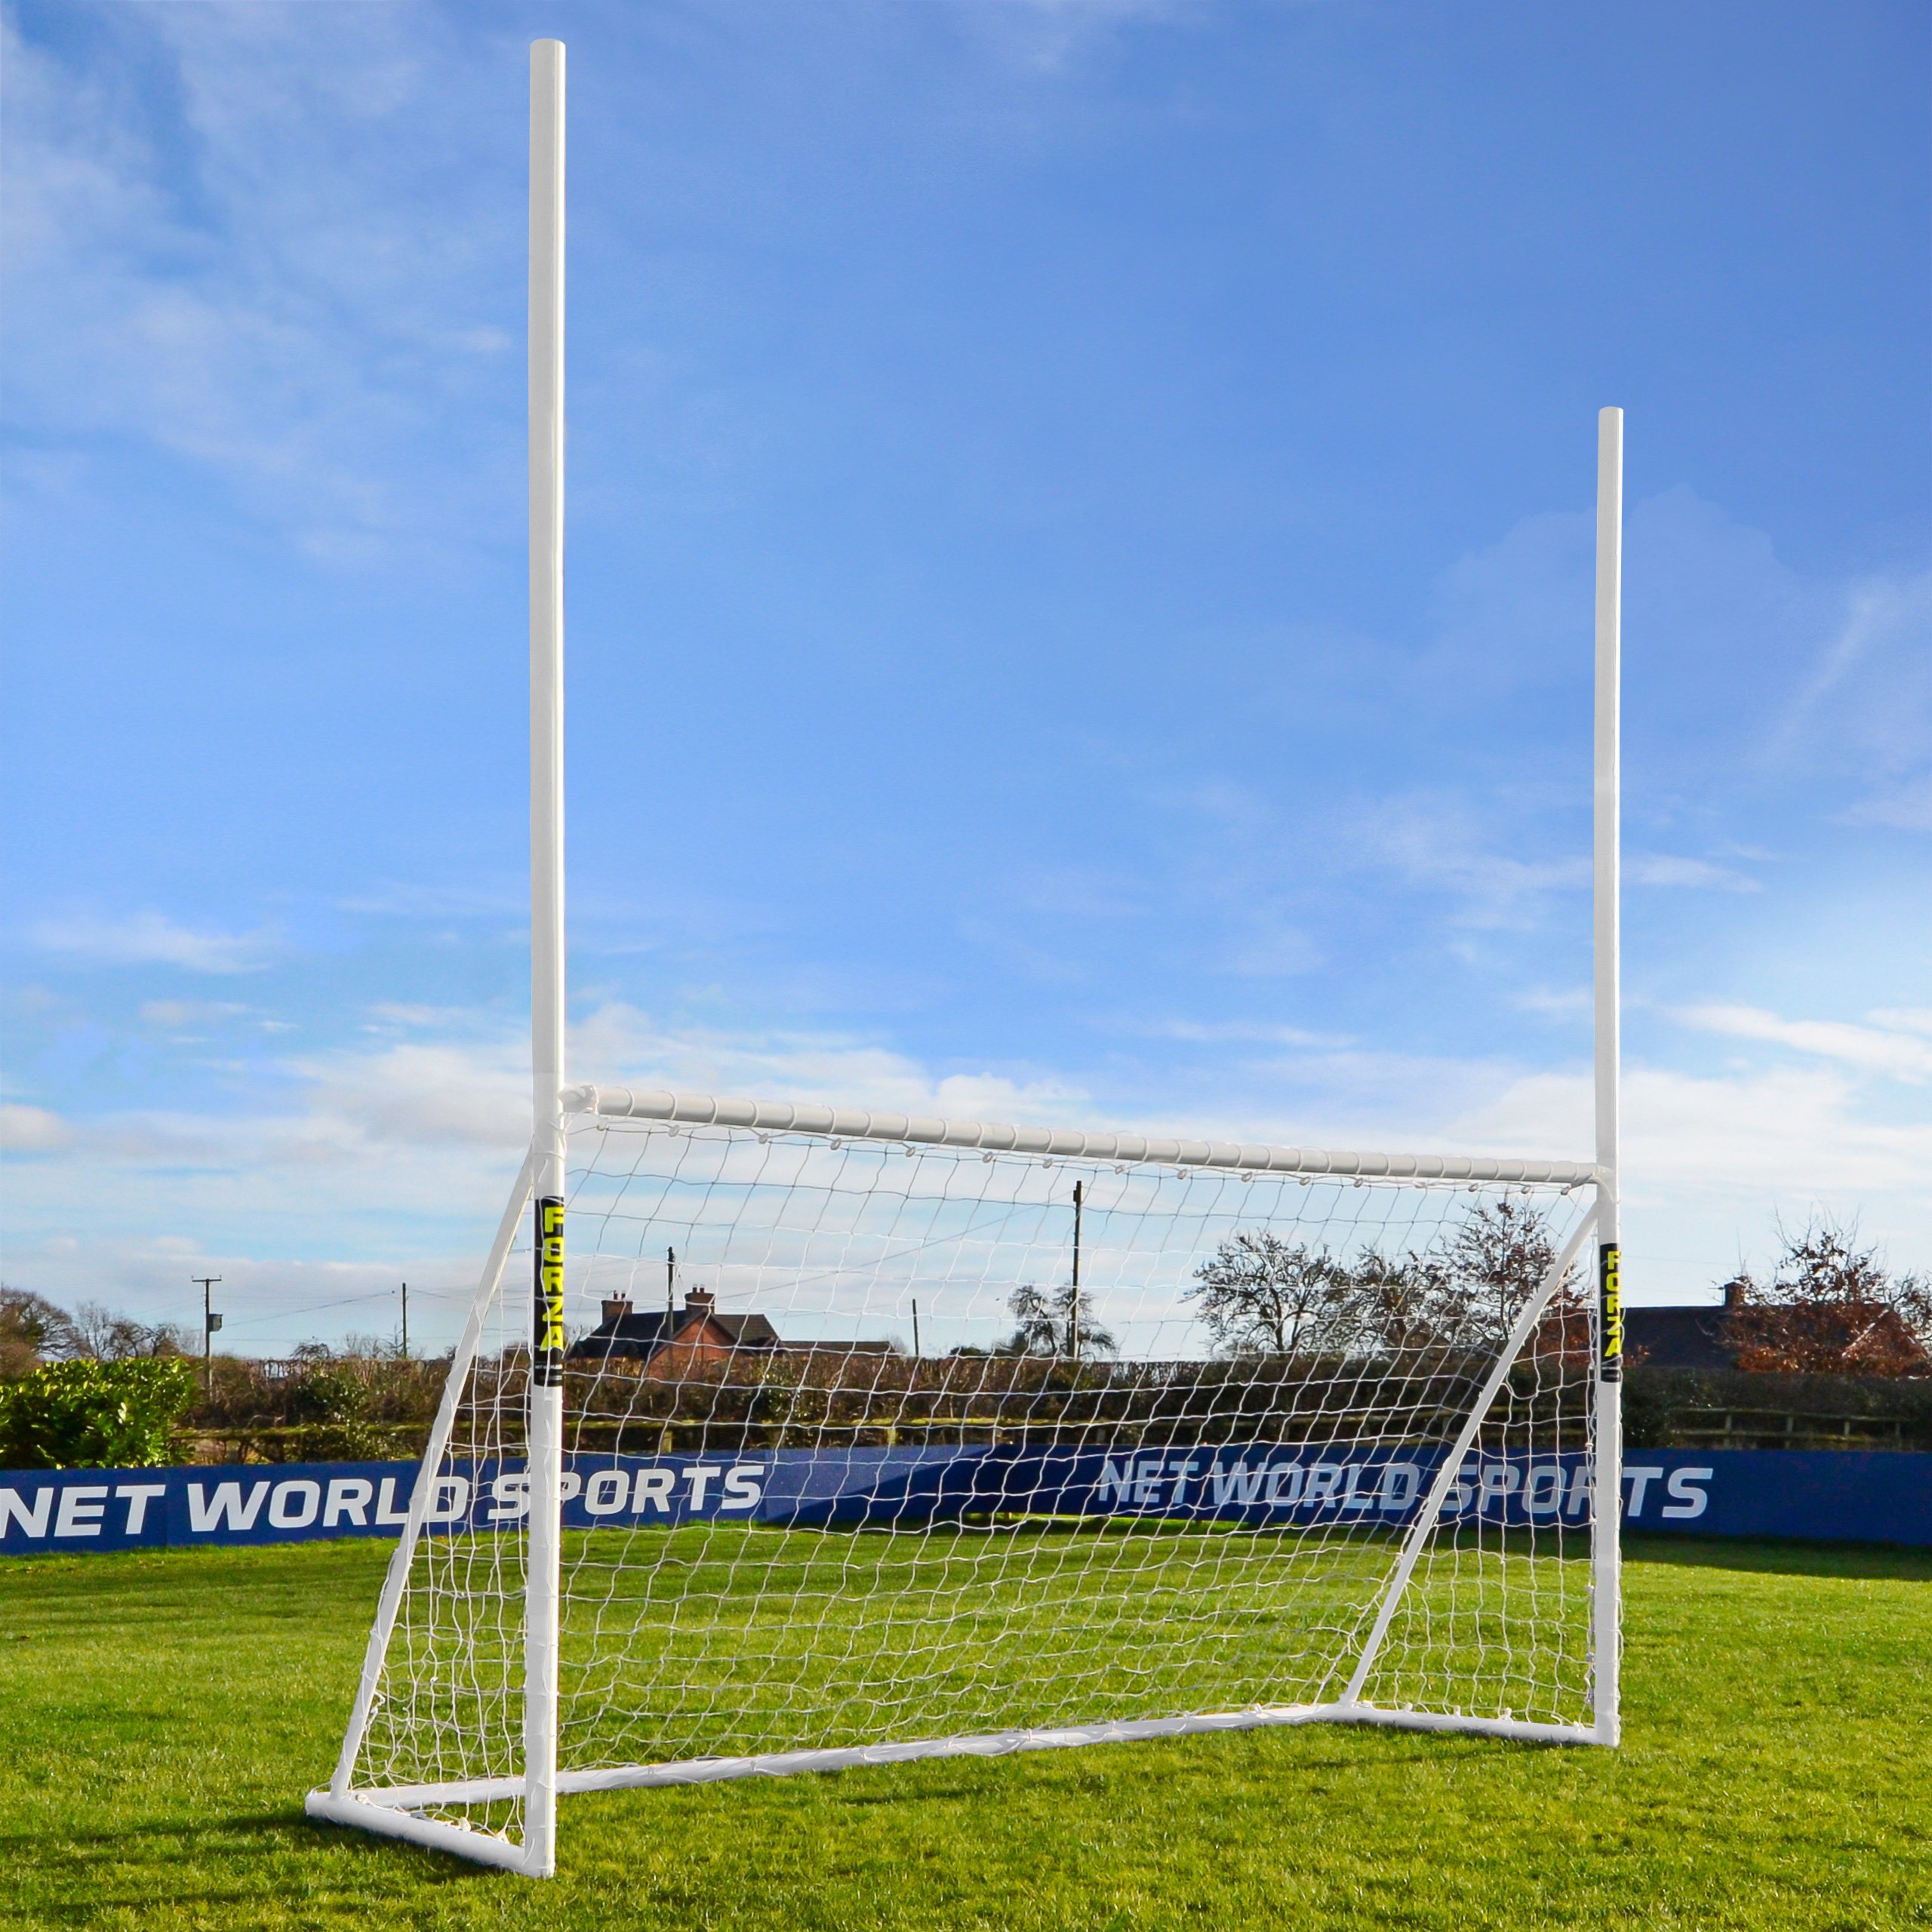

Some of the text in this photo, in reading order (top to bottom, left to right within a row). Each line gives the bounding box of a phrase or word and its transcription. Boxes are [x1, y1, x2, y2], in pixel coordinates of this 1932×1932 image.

[540, 1207, 565, 1352] FORZA
[1604, 1251, 1621, 1357] FORZA
[0, 1484, 166, 1540] NET
[187, 1475, 469, 1532] WORLD
[1098, 1460, 1199, 1504] NET
[1212, 1462, 1420, 1510] WORLD
